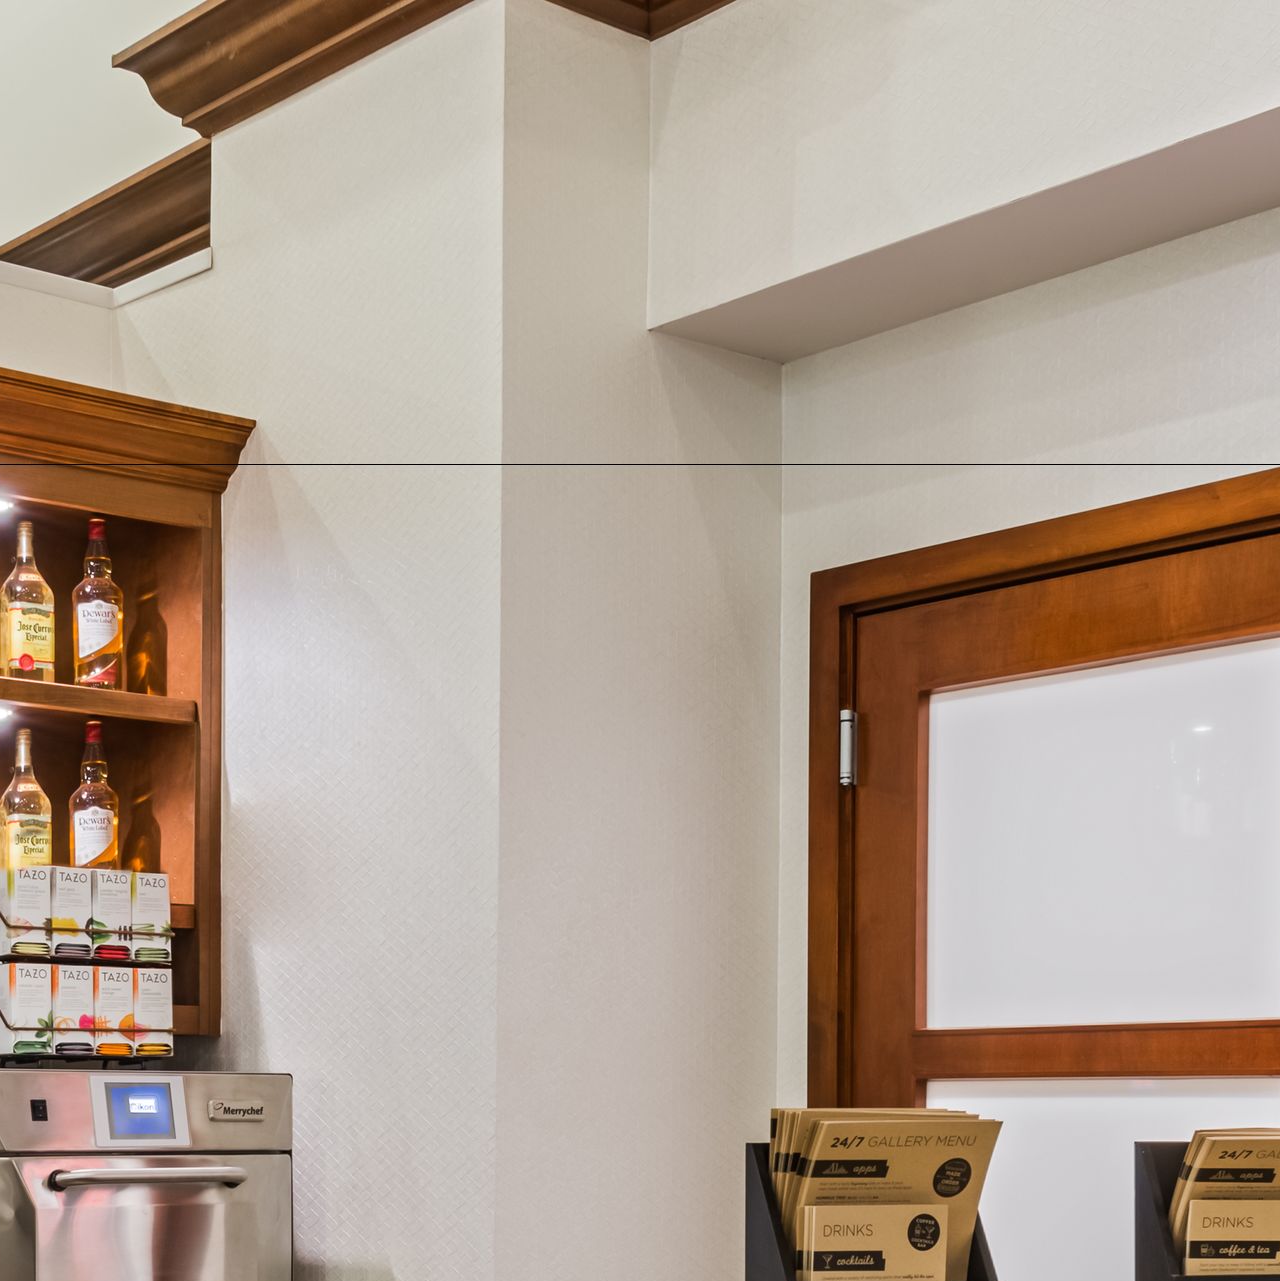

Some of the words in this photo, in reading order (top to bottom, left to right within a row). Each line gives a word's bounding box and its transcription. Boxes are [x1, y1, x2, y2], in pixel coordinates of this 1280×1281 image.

[18, 869, 47, 881] TAZO
[59, 871, 88, 883] TAZO
[100, 873, 128, 885] TAZO
[139, 877, 166, 889] TAZO
[18, 968, 47, 979] TAZO
[61, 970, 90, 981] TAZO
[101, 972, 130, 983] TAZO
[140, 972, 168, 984] TAZO
[223, 1106, 264, 1117] Merrychef
[831, 1135, 865, 1149] 24/7
[867, 1135, 933, 1147] GALLERY
[935, 1135, 977, 1147] MENU
[1218, 1150, 1253, 1160] 24/7
[853, 1165, 878, 1175] apps
[1202, 1216, 1254, 1228] DRINKS
[823, 1223, 874, 1237] DRINKS
[1219, 1244, 1246, 1257] coffee
[1257, 1245, 1271, 1254] tea
[836, 1254, 875, 1266] cocktails
